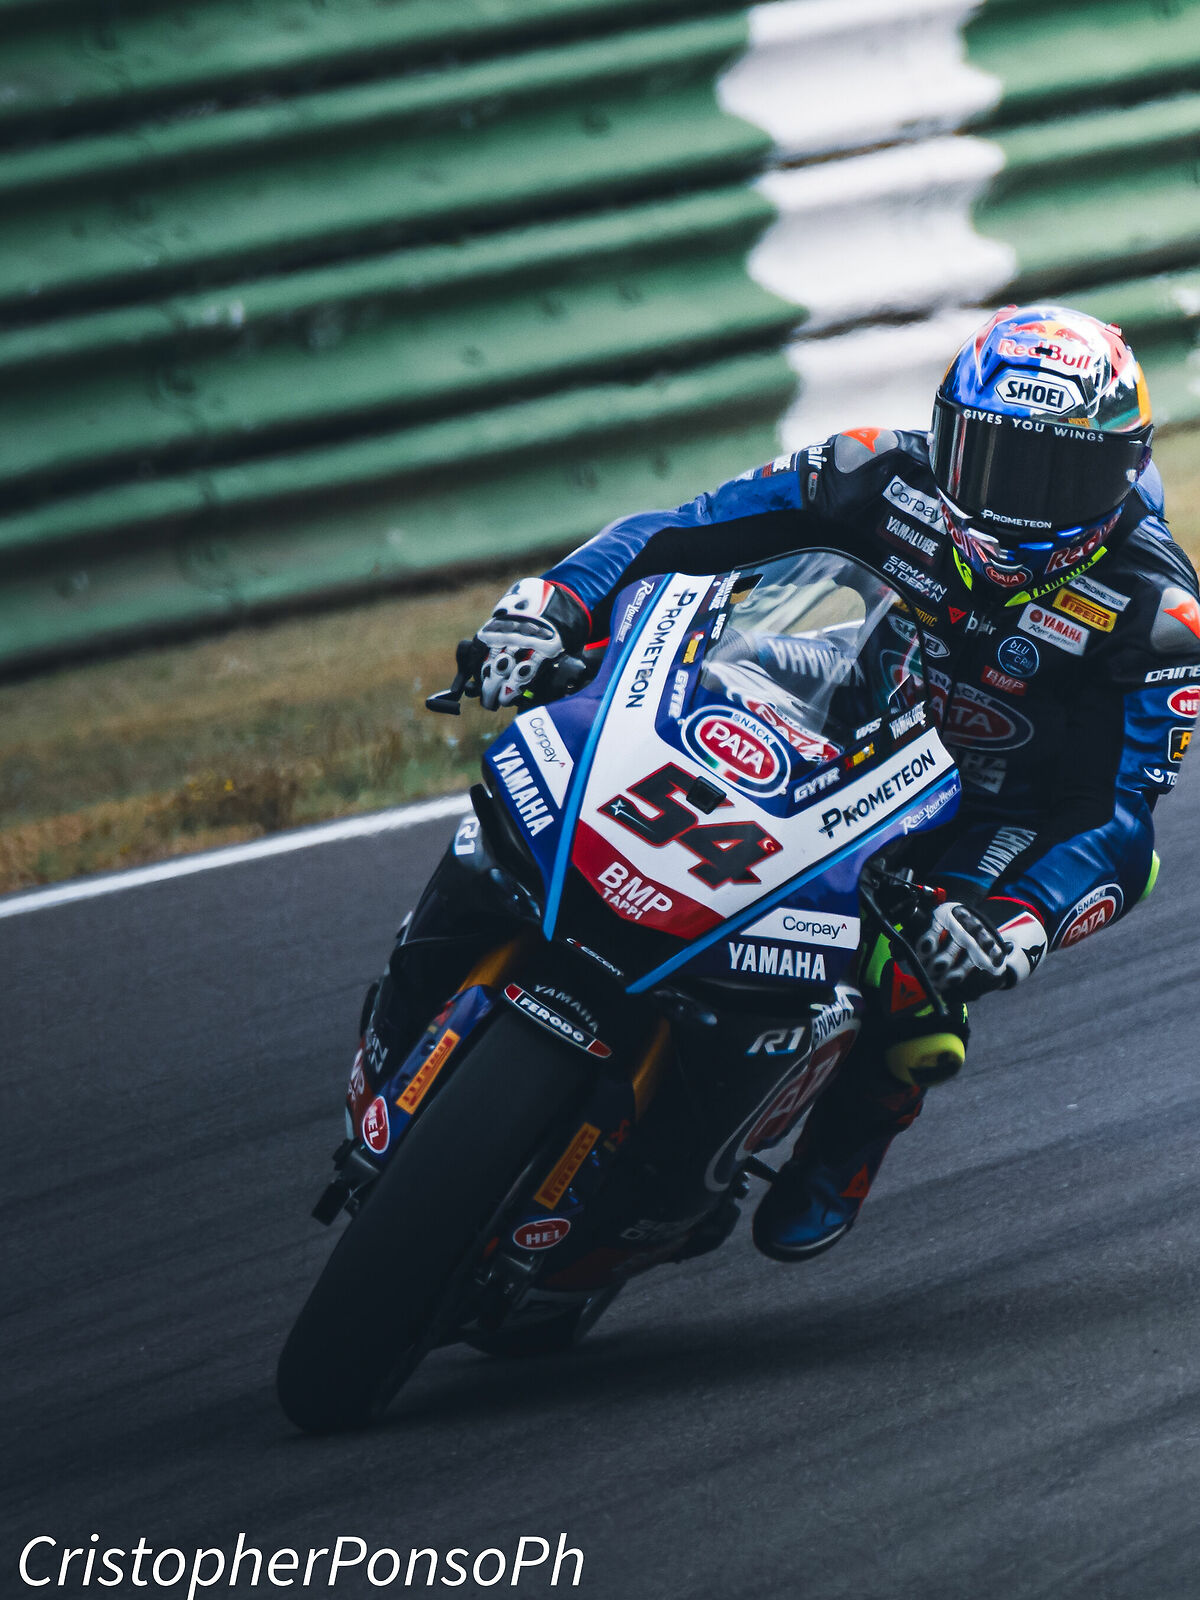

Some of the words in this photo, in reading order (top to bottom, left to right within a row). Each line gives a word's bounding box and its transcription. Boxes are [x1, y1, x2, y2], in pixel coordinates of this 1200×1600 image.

[1048, 343, 1092, 370] Bull
[1006, 380, 1065, 409] SHOEI
[963, 408, 1003, 426] GIVES
[1012, 418, 1045, 434] YOU
[1054, 427, 1105, 443] WINGS
[889, 480, 943, 524] Corpay
[981, 509, 1053, 529] PROMETEON
[885, 515, 940, 558] YAMALUBE
[882, 563, 897, 578] DI
[897, 569, 943, 603] DEPAN
[888, 555, 948, 596] SEMAKIN
[625, 587, 700, 709] PROMETEON
[1043, 614, 1083, 643] YAMAHA
[1179, 699, 1200, 712] HE
[529, 716, 561, 765] Corpay
[706, 722, 766, 775] PATA
[732, 712, 773, 747] SNACK
[492, 742, 554, 838] YAMAHA
[794, 767, 841, 803] GYTR
[818, 748, 937, 839] PROMETEON
[597, 761, 784, 891] 54
[977, 826, 1038, 878] YAMAHA
[597, 861, 674, 914] BMP
[602, 888, 643, 921] TAPPI
[1076, 888, 1107, 918] SNACK
[782, 916, 841, 940] Corpay
[1067, 907, 1107, 943] PATA
[729, 942, 827, 982] YAMAHA
[518, 996, 586, 1043] FERODO
[533, 983, 600, 1034] YAMAHA
[745, 1026, 806, 1056] R1
[367, 1104, 381, 1145] HEL
[525, 1229, 561, 1246] HEL
